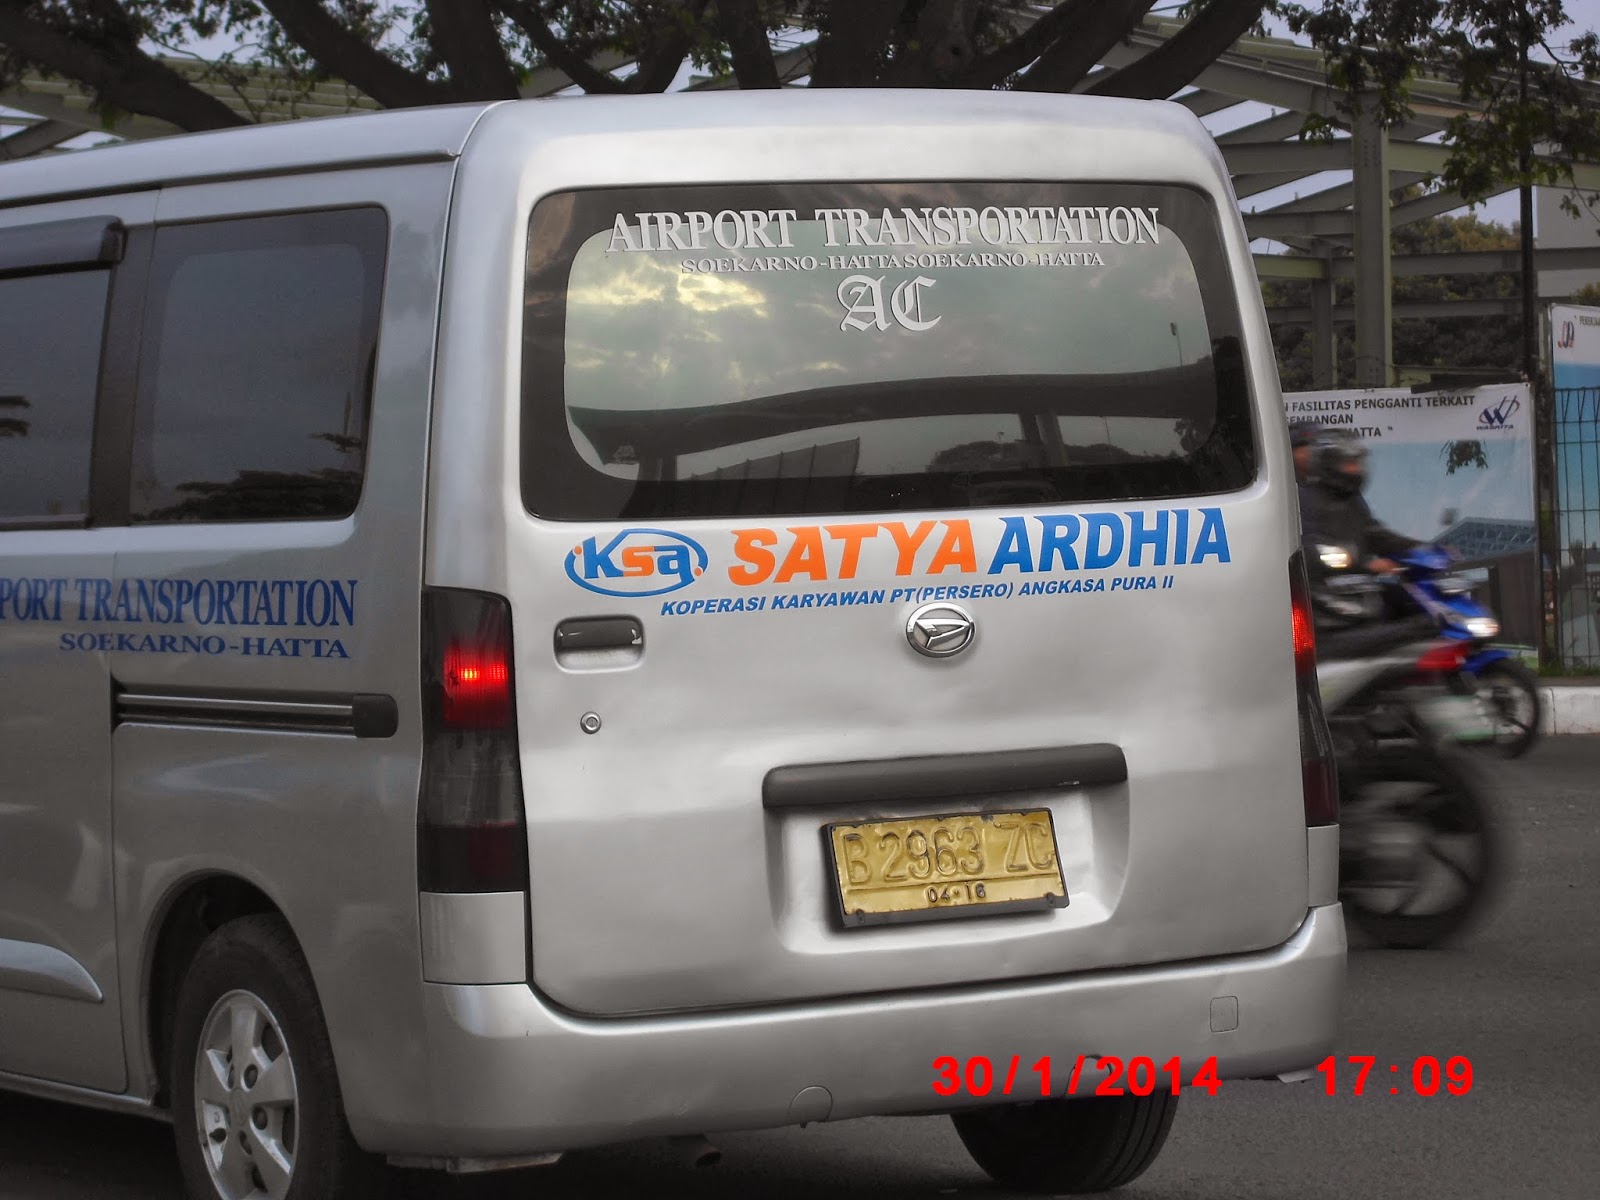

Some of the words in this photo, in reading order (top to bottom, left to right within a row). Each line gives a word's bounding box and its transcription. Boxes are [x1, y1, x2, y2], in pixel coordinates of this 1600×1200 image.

[606, 210, 797, 254] AIRPORT
[815, 206, 1160, 247] TRANSPORTATION
[837, 274, 942, 332] AC
[1292, 399, 1351, 412] FASILITAS
[1354, 397, 1423, 409] PENGGANTI
[1425, 395, 1475, 407] TERKAIT
[727, 519, 977, 586] SATYA
[987, 508, 1231, 575] ARDHIA
[75, 578, 357, 626] TRANSPORTATION
[661, 597, 765, 615] KOPERASI
[771, 589, 885, 610] KARYAWAN
[889, 582, 1014, 604] PT(PERSERO)
[1018, 578, 1105, 596] ANGKASA
[1110, 576, 1157, 591] PURA
[1162, 575, 1174, 589] II
[60, 633, 350, 658] SOEKARNO-HATTA
[843, 833, 870, 883] B
[878, 826, 985, 882] 2963
[993, 821, 1053, 873] ZC
